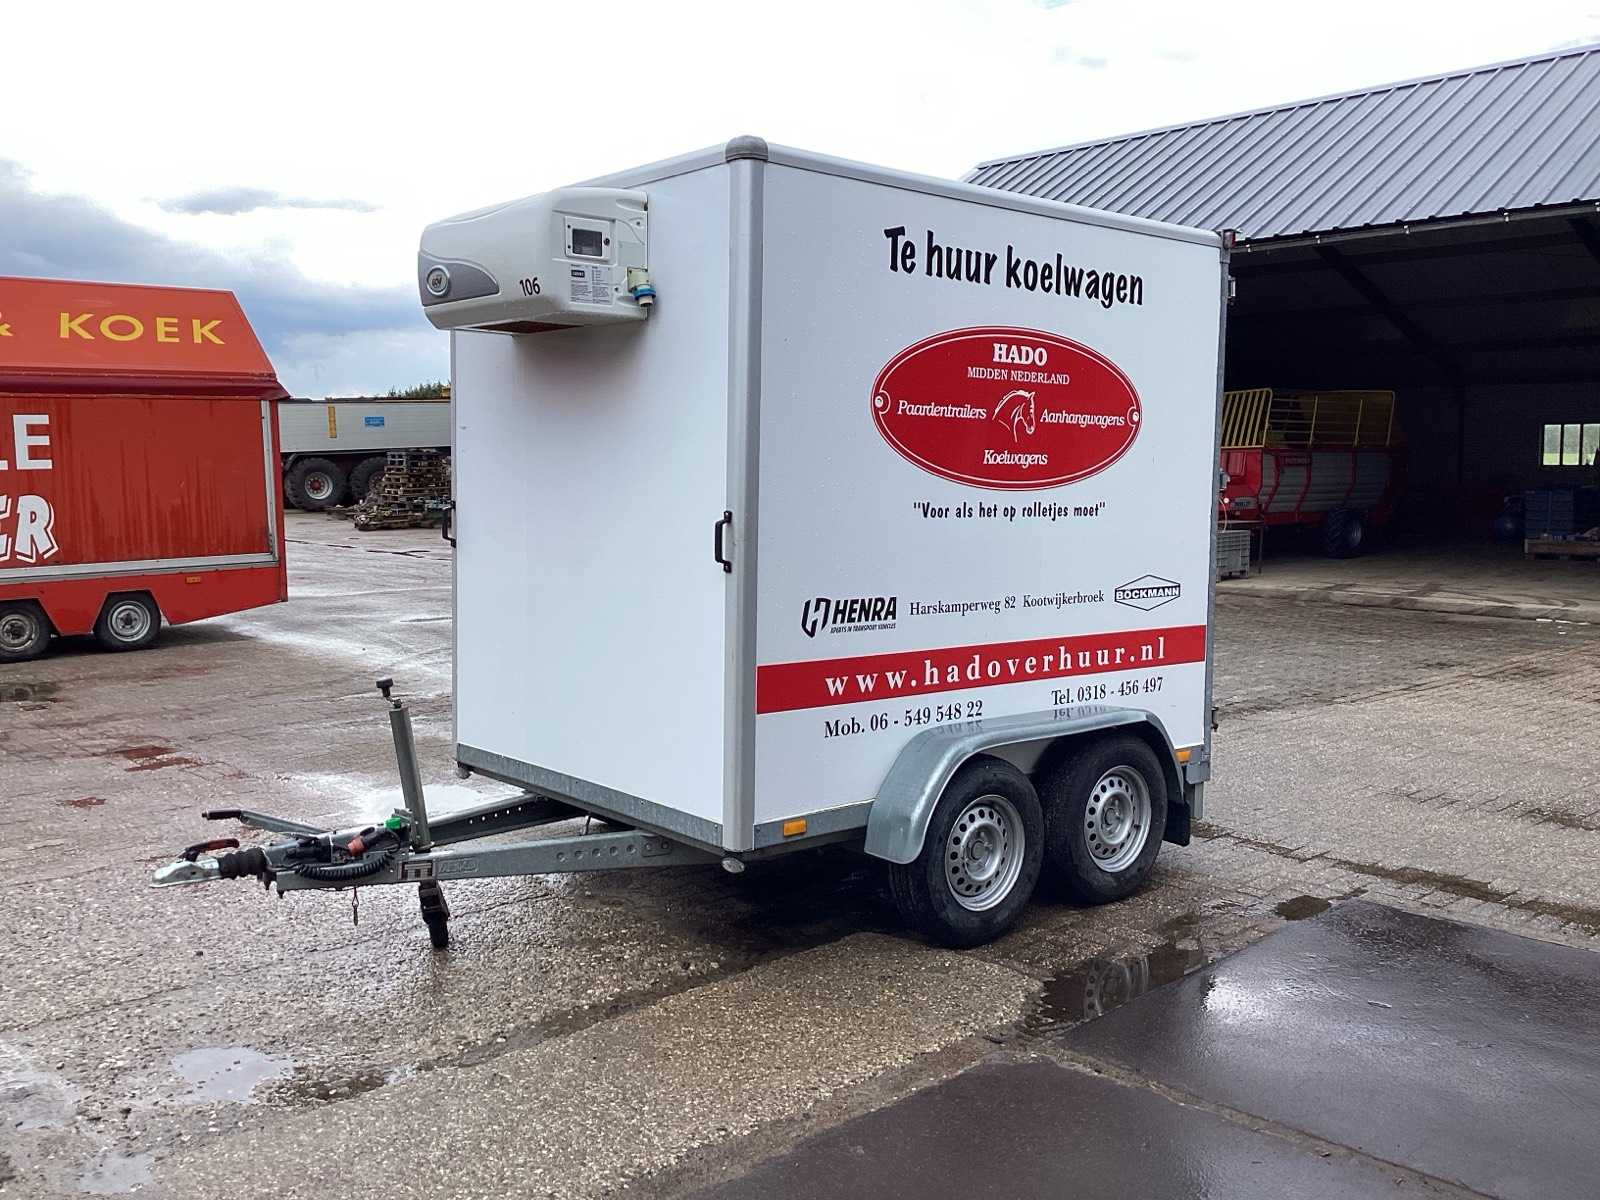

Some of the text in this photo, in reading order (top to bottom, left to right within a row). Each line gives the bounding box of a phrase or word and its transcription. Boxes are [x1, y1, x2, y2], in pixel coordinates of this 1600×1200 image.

[883, 225, 1143, 309] Te huur koelwagen
[519, 276, 541, 297] 106
[59, 312, 226, 345] KOEK
[992, 342, 1048, 366] HADO
[967, 366, 1070, 385] MIDDEN NEDERLAND
[897, 399, 987, 420] Paardentrailers
[1040, 408, 1125, 429] Aanhangwagens
[0, 414, 53, 470] E
[983, 449, 1048, 469] Koelwagens
[913, 501, 1106, 522] "Voor als het op rolletjes moet"
[832, 596, 897, 625] HENRA
[909, 589, 1105, 617] Harskamperweg 82 Kootwijkerbroek
[825, 636, 1166, 697] www.hadoverhuur.nl
[1051, 688, 1074, 705] Tel.
[1077, 684, 1106, 702] 0318
[1118, 680, 1139, 696] 456
[1143, 676, 1163, 693] 497
[824, 716, 866, 738] Mob.
[870, 712, 888, 732] 06
[904, 707, 931, 727] 549
[936, 702, 962, 722] 548
[966, 699, 983, 718] 22
